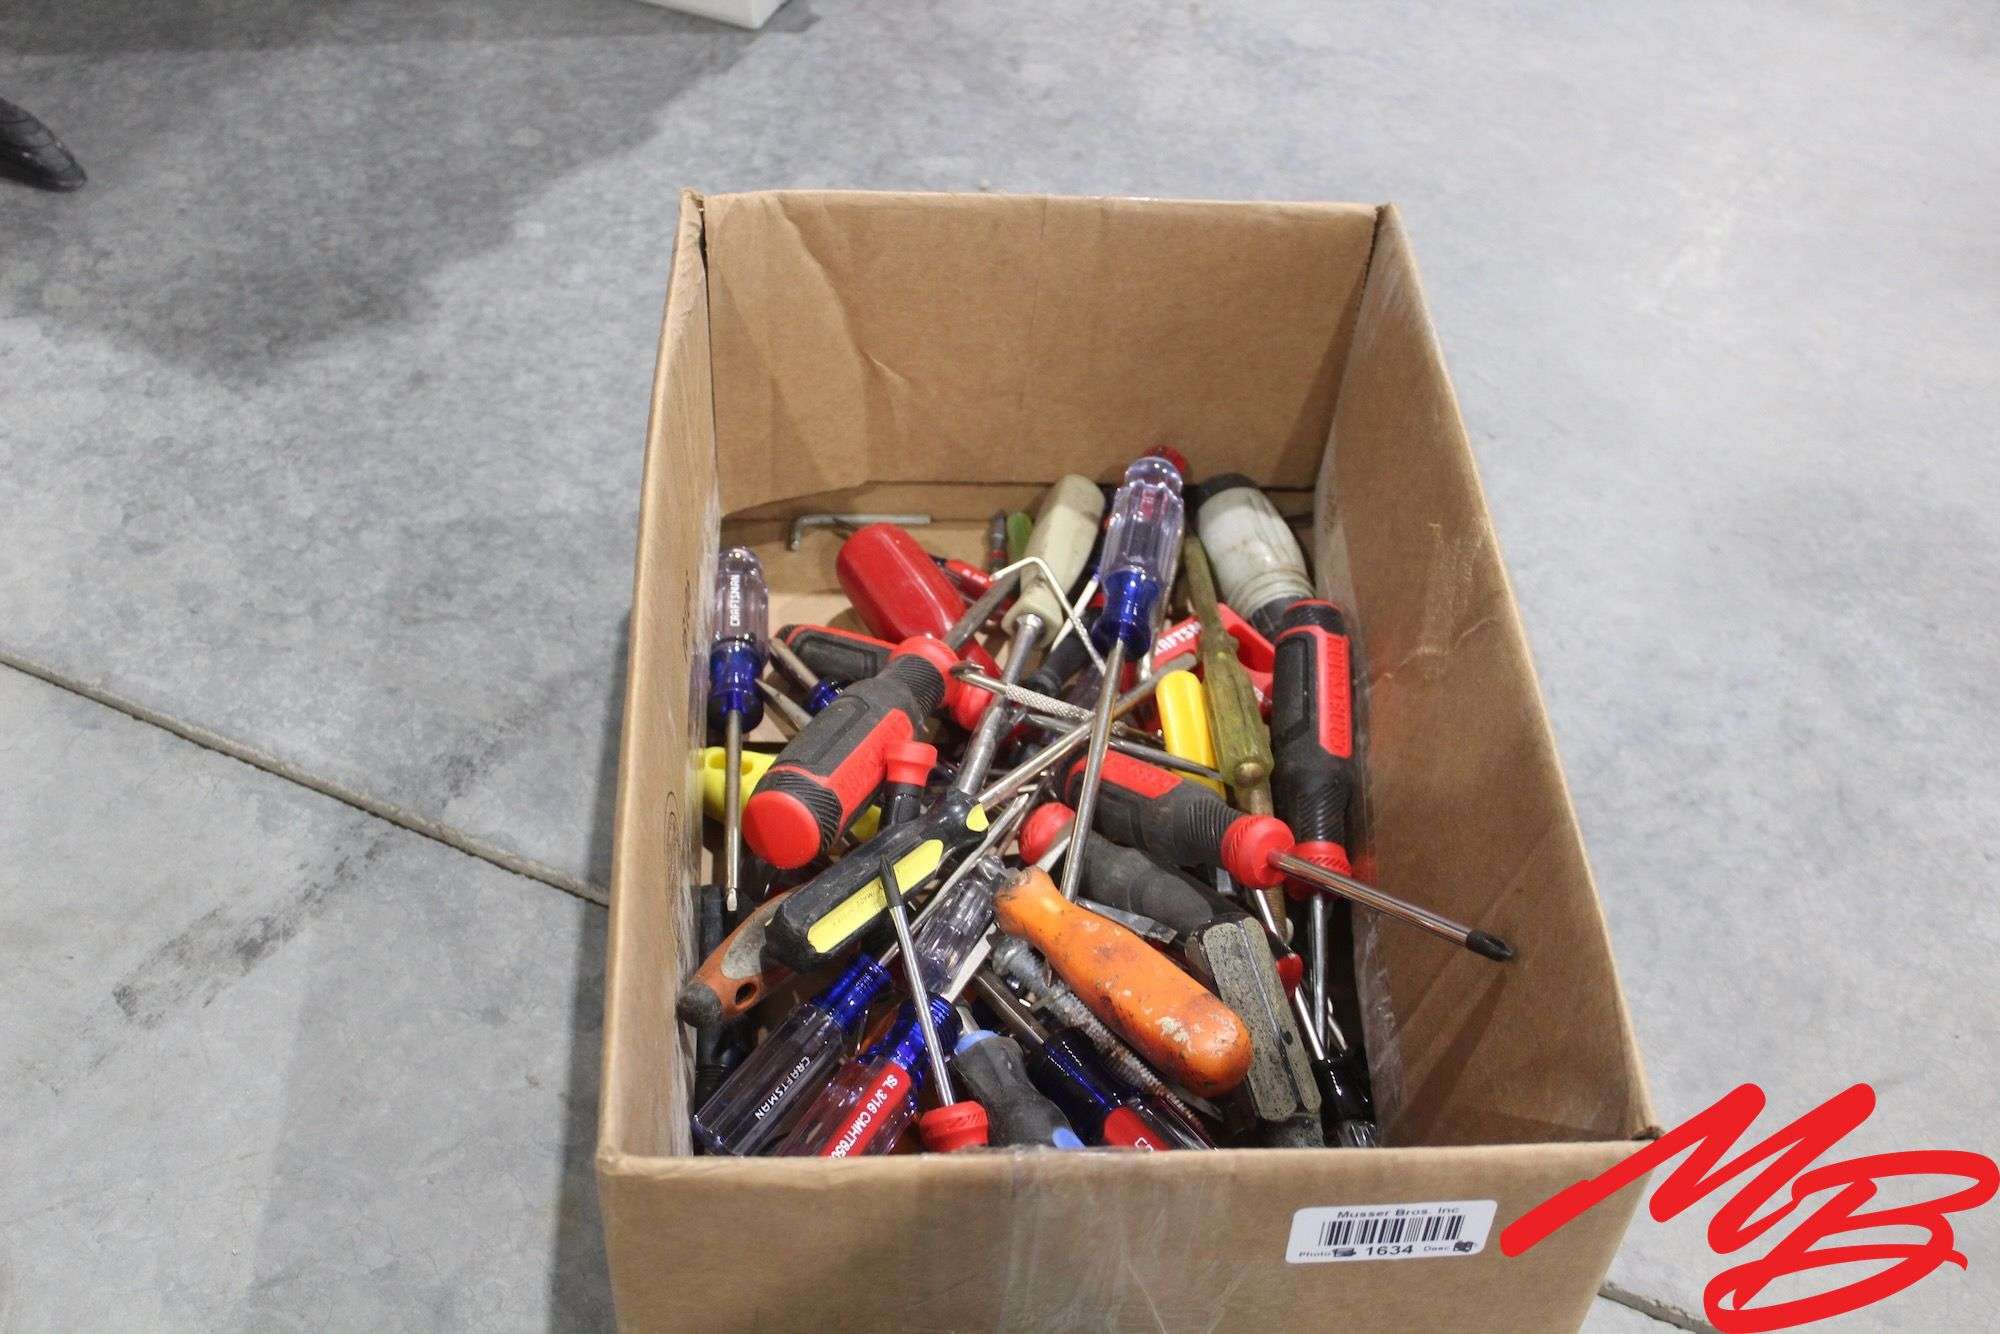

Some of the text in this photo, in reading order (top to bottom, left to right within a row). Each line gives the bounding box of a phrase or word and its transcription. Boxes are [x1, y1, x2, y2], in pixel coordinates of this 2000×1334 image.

[755, 1055, 811, 1120] CRAFTSMAN
[882, 1074, 898, 1089] SL
[866, 1088, 888, 1114] 3/16
[1337, 1210, 1390, 1218] Musser
[1365, 1244, 1414, 1256] 1634
